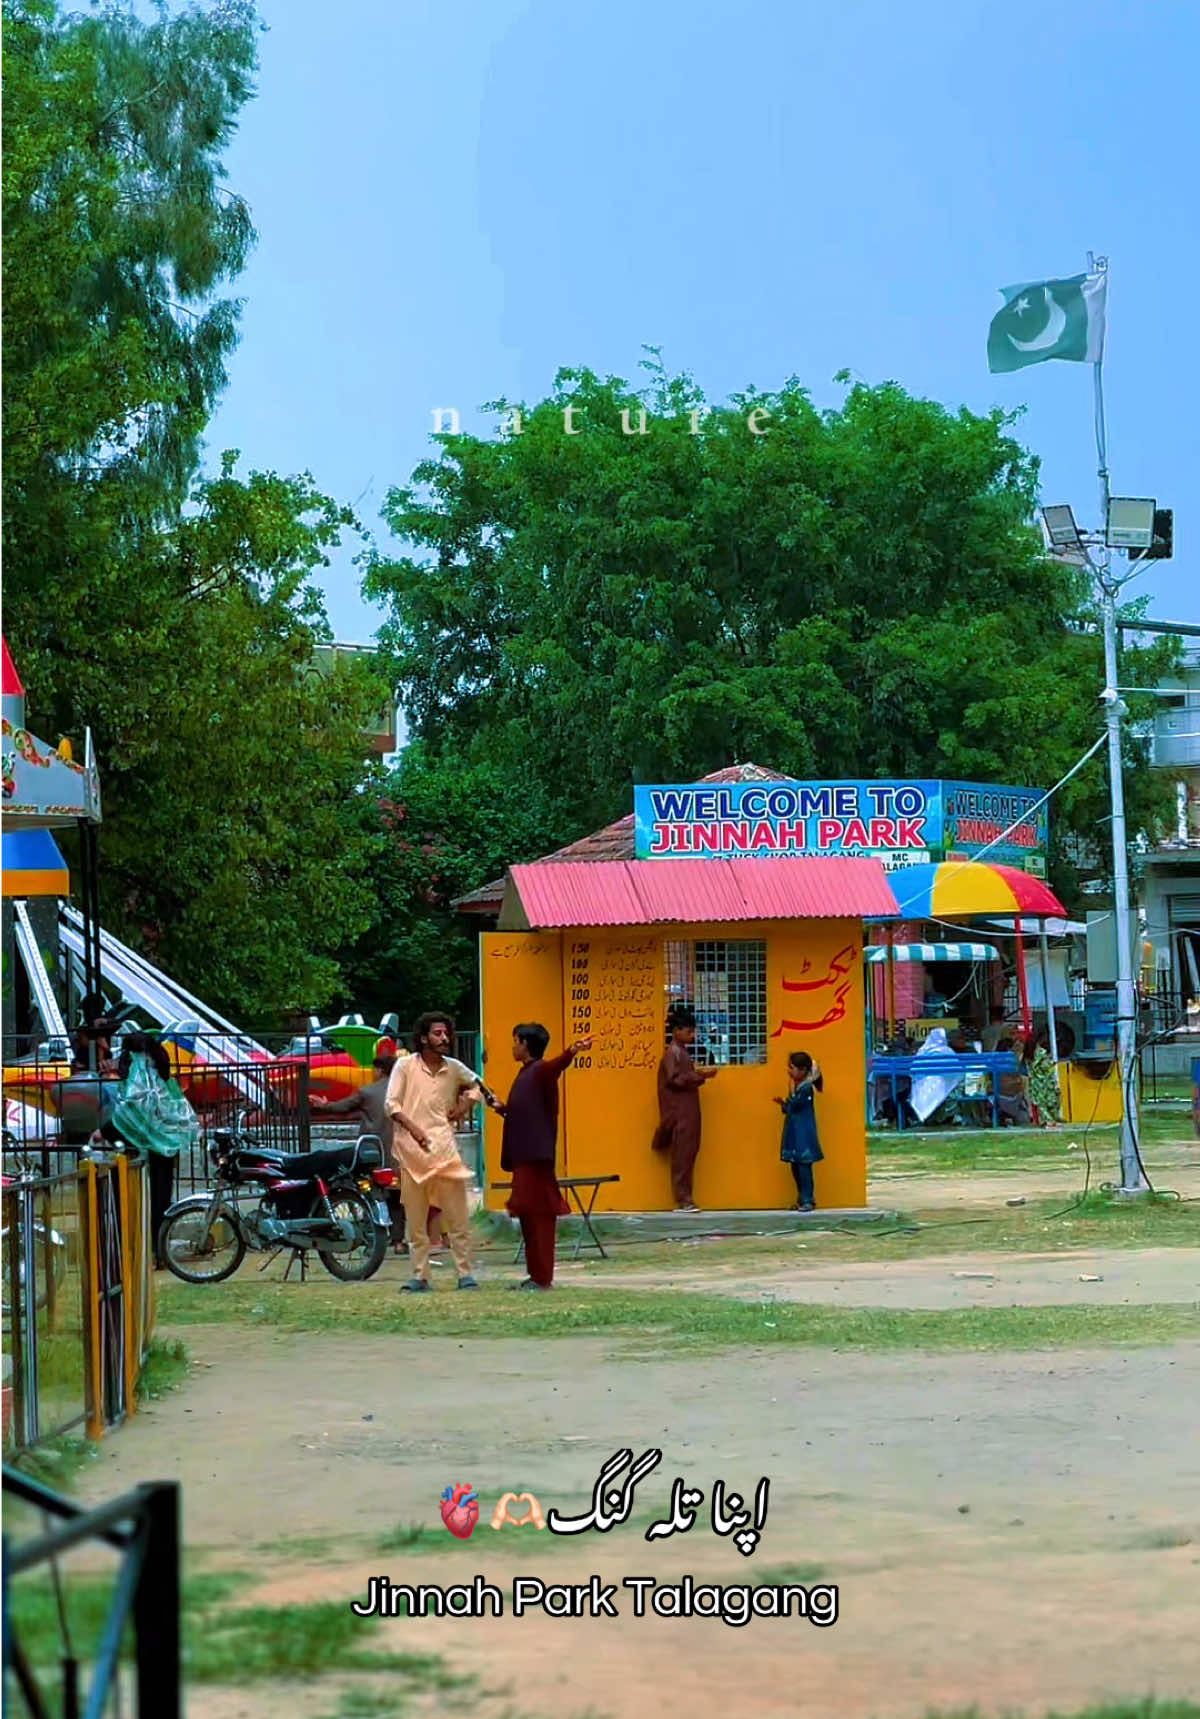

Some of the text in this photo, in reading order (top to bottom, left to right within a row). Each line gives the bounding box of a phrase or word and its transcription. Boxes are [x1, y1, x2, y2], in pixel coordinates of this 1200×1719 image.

[651, 785, 926, 820] WELCOME TO
[955, 789, 1038, 823] WELCOME TO
[650, 818, 927, 852] JINNAH PARK
[956, 818, 1003, 845] JINNAH
[891, 853, 909, 862] MC
[782, 943, 857, 992] ٹکٹ
[571, 973, 589, 986] 100
[571, 989, 590, 1001] 100
[572, 1005, 592, 1018] 150
[770, 980, 852, 1038] گھر
[573, 1022, 591, 1034] 150
[573, 1056, 592, 1069] 100
